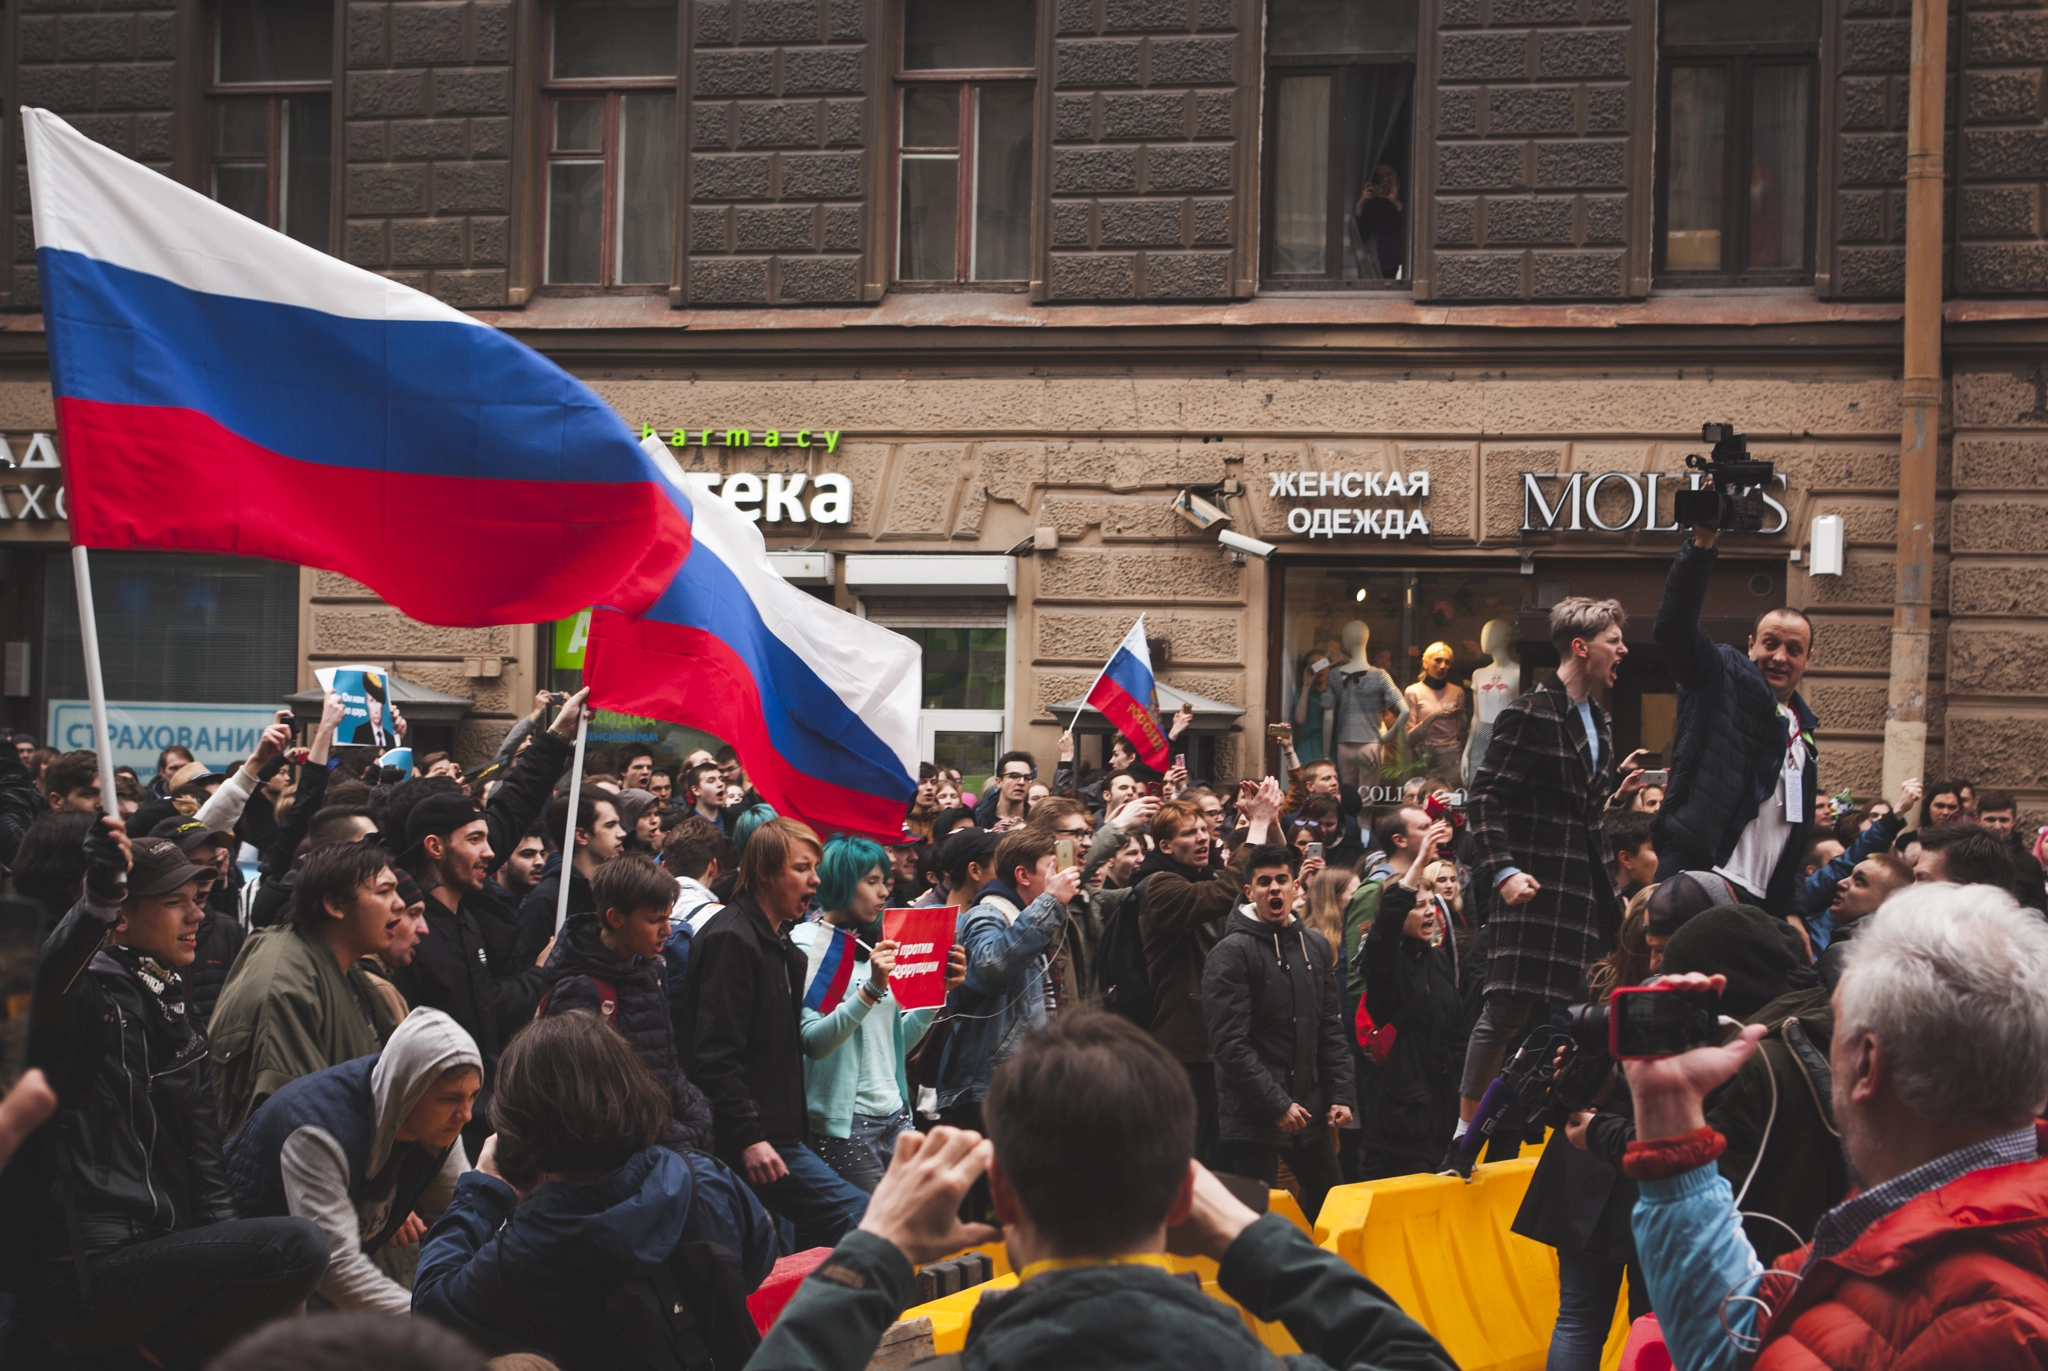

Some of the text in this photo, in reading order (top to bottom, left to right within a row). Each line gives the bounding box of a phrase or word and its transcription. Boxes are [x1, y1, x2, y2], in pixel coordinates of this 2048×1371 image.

[1268, 471, 1430, 498] ЖЕНСКАЯ
[1519, 471, 1789, 534] MOLS
[1287, 507, 1430, 540] ОДЕЖДА
[66, 723, 264, 752] СТРАХОВАНИ
[899, 942, 934, 959] против
